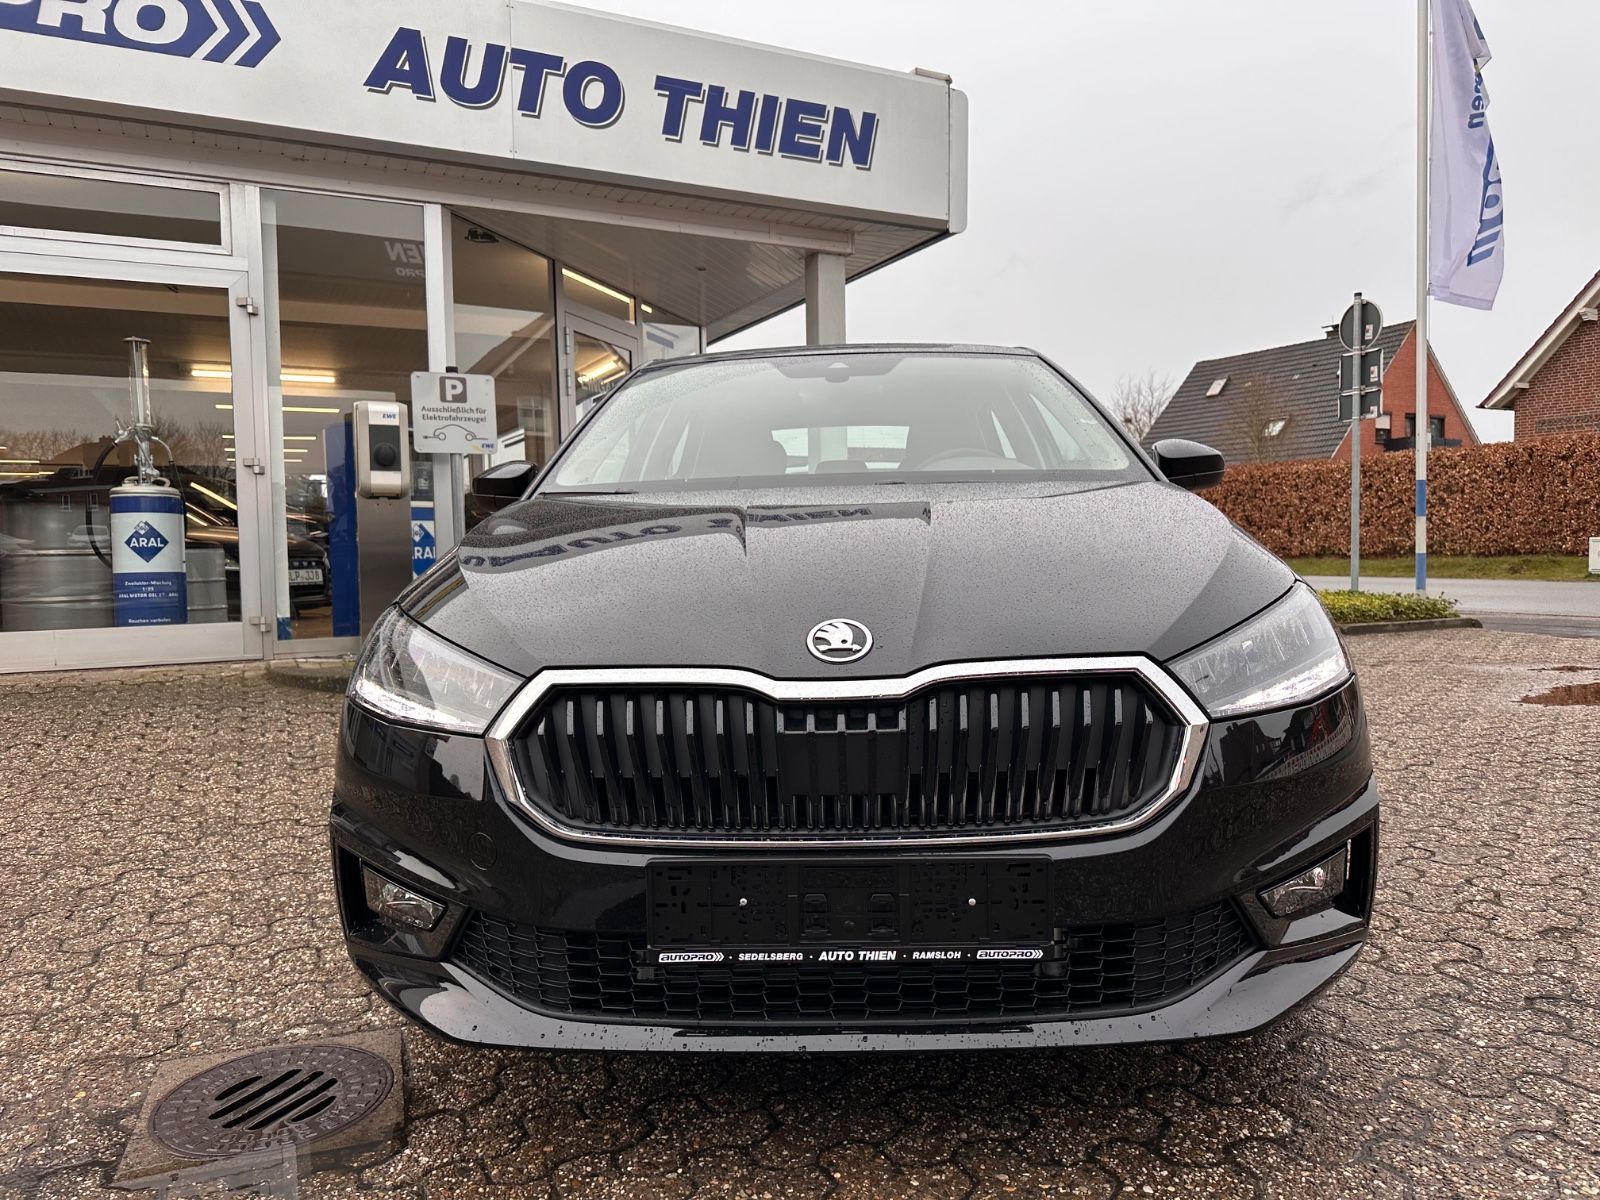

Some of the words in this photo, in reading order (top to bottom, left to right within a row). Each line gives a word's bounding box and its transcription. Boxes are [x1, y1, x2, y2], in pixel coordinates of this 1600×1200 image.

[0, 0, 188, 44] RO
[364, 27, 624, 129] AUTO
[655, 75, 878, 171] THIEN
[445, 379, 463, 400] P
[421, 405, 474, 414] Ausschließlich
[422, 414, 487, 423] Elektrofahrzeuge!
[130, 537, 165, 548] ARAL
[412, 546, 436, 559] RA
[738, 952, 803, 961] SEDELSBERG
[818, 951, 854, 961] AUTO
[858, 951, 897, 961] THIEN
[912, 951, 961, 959] RAMSLOH
